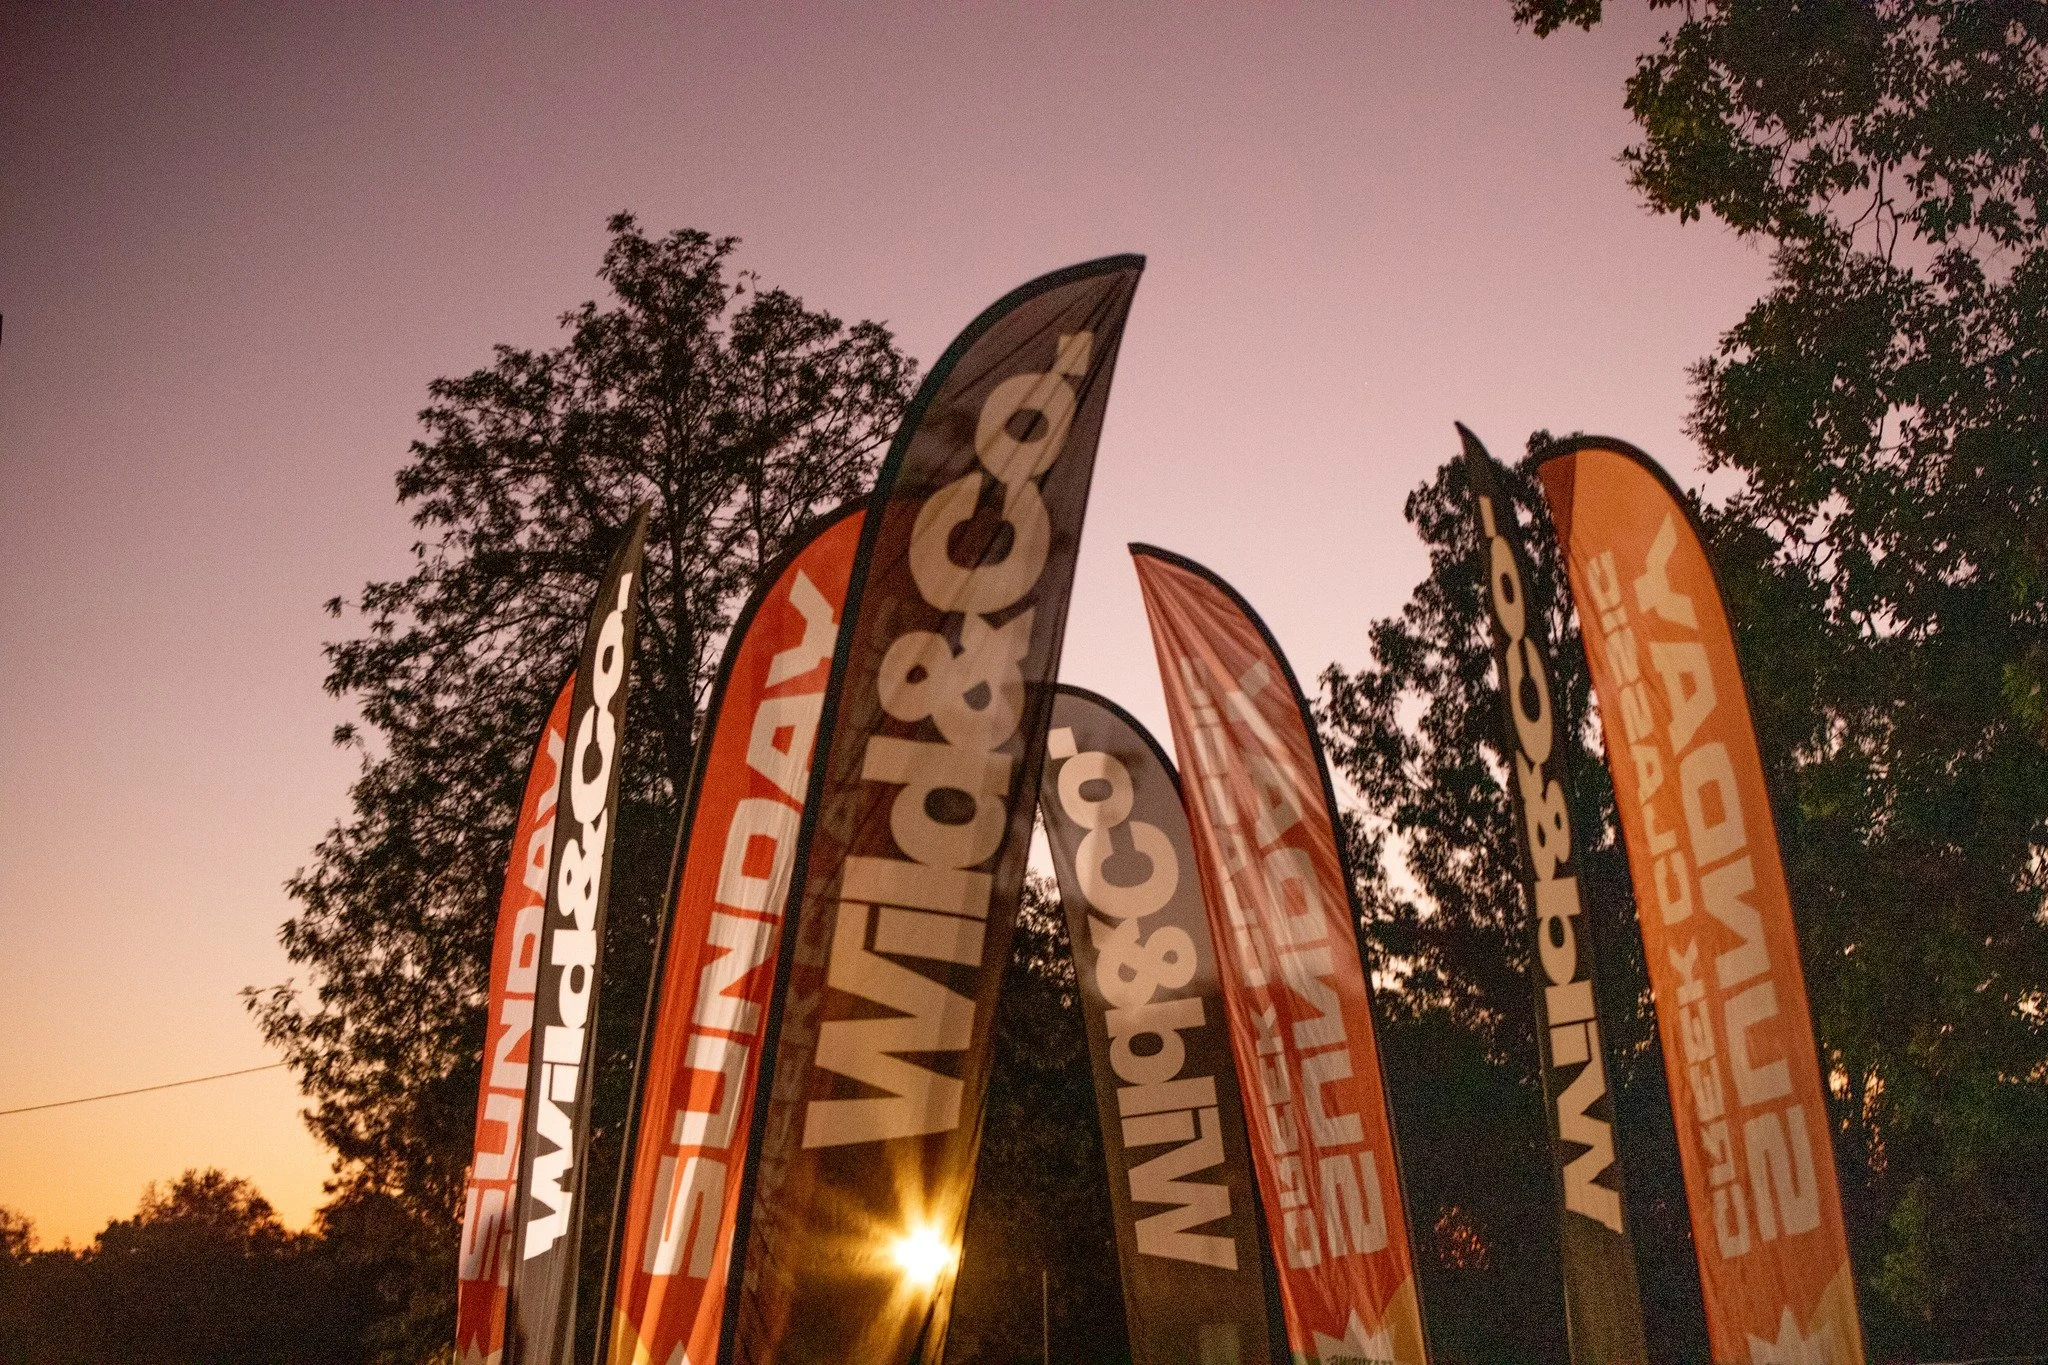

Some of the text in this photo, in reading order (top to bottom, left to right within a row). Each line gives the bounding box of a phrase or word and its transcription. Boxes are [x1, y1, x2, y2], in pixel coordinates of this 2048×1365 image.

[458, 727, 565, 1281] SUNDAY
[643, 569, 840, 1279] SUNDAY
[802, 332, 1093, 1149] Wild&Co.
